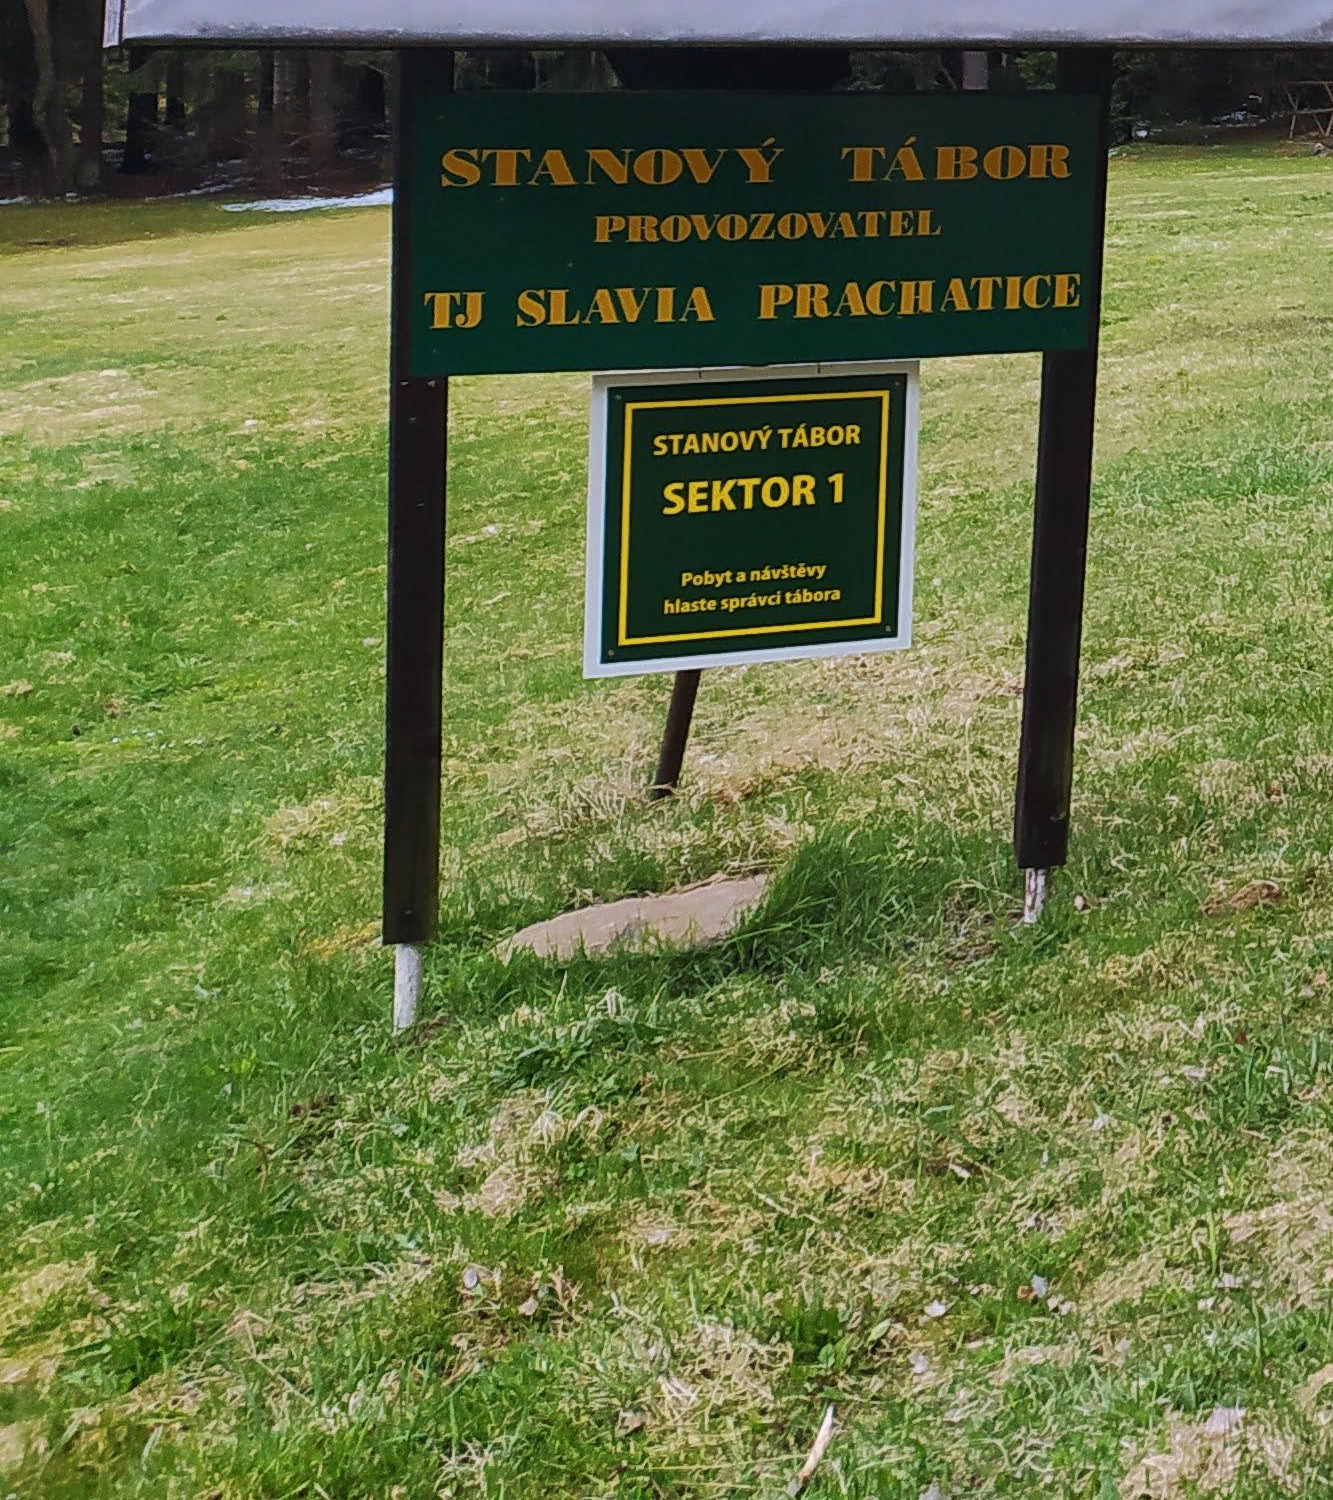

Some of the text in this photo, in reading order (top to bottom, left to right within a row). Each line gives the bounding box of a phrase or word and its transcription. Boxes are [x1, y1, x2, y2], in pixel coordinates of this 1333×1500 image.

[440, 135, 1072, 188] STANOVÝ TÁBOR
[593, 208, 942, 244] PROVOZOVATEL
[423, 273, 1082, 330] TJ SLAVIA PRACHATICE
[652, 422, 862, 457] STANOVÝ TÁBOR
[662, 472, 845, 516] SEKTOR 1
[681, 561, 827, 589] Pobyt a návštěvy
[663, 586, 841, 615] hlaste správci tábora
